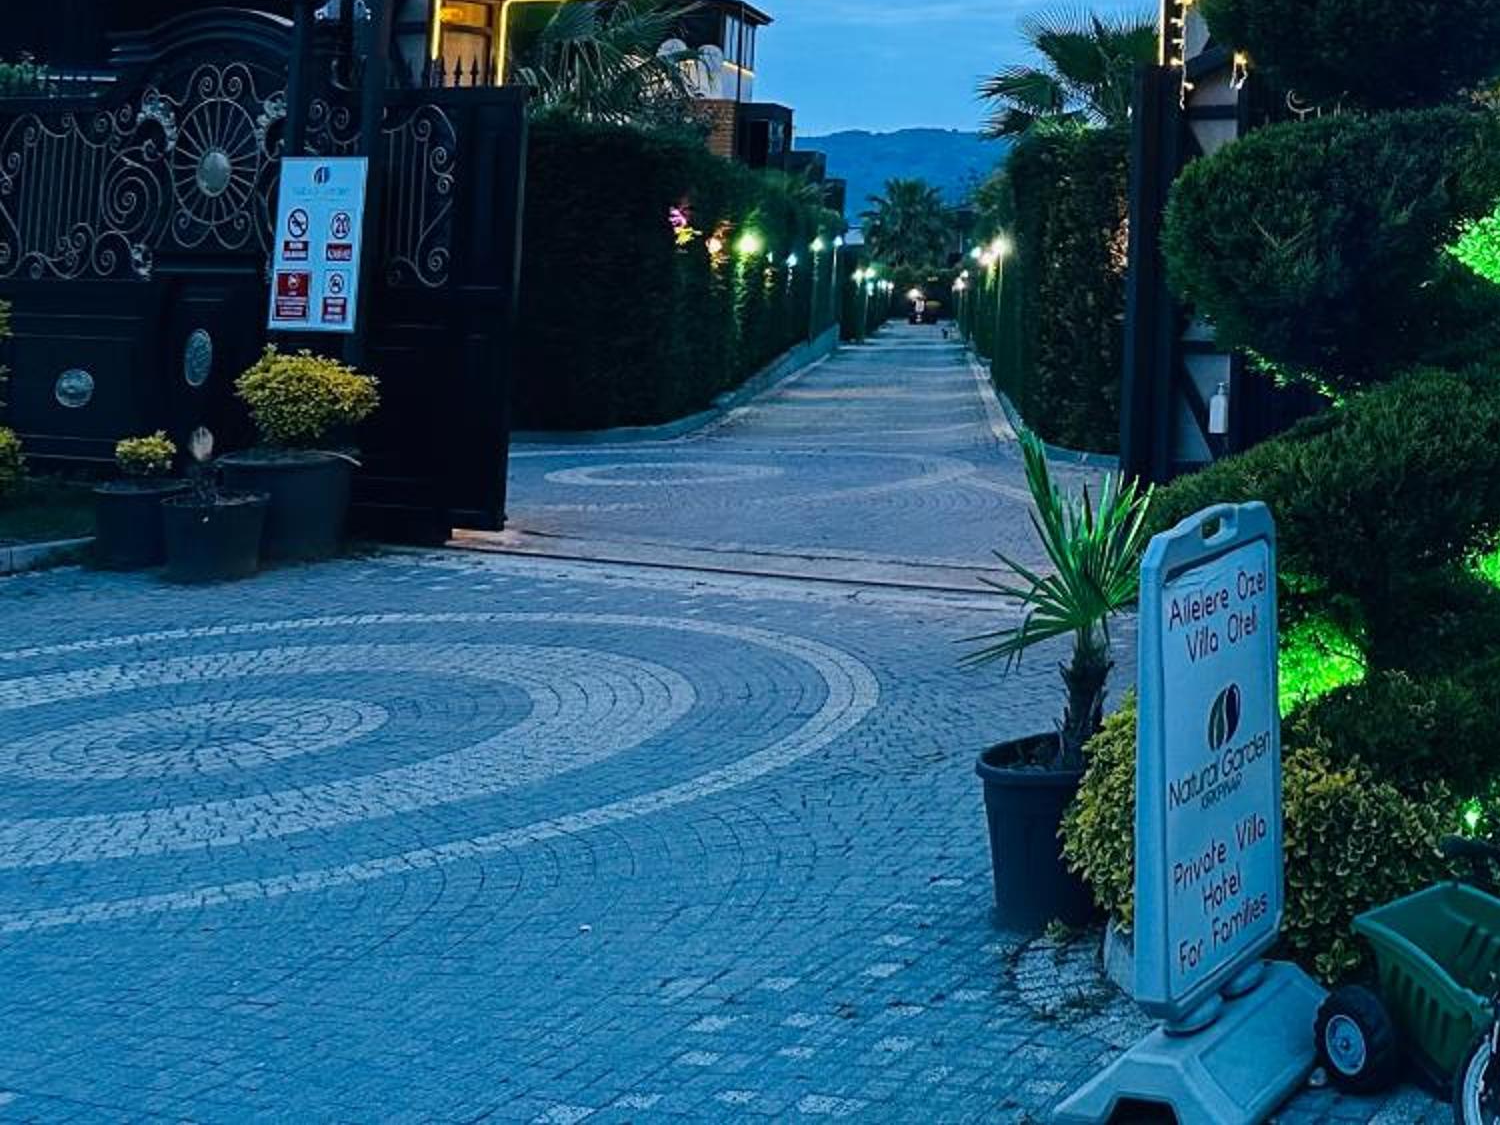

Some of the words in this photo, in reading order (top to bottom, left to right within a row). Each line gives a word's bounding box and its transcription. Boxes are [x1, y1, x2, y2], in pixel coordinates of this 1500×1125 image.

[1168, 587, 1230, 632] Ailelere
[1185, 625, 1219, 663] Villa
[1227, 604, 1258, 644] Otel
[1168, 756, 1220, 811] Natural
[1221, 730, 1271, 777] Garden
[1173, 838, 1227, 894] Private
[1236, 812, 1267, 851] Villa
[1202, 863, 1242, 915] Hotel
[1179, 938, 1204, 975] For
[1212, 892, 1268, 949] Families
